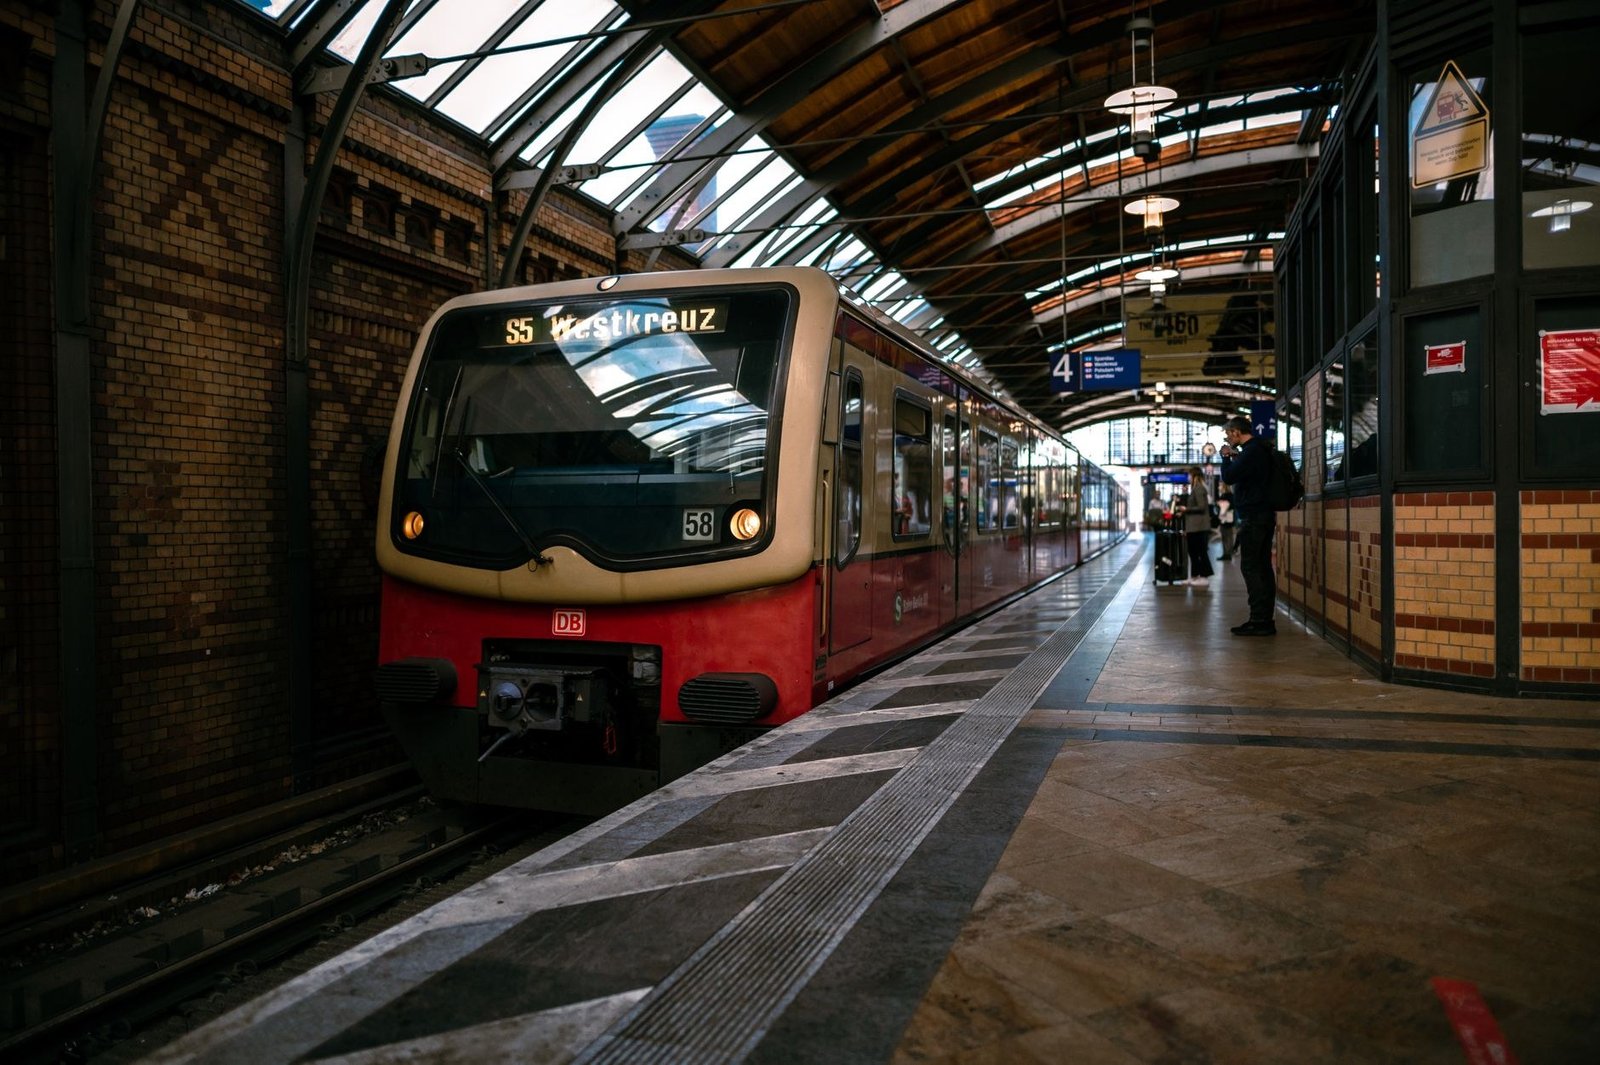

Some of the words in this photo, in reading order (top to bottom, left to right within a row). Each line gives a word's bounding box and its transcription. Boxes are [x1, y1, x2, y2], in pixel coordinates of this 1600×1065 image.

[506, 317, 533, 344] S5
[551, 308, 716, 342] Westkreuz
[1052, 353, 1074, 383] 4
[685, 512, 712, 537] 58
[556, 613, 582, 631] DB
